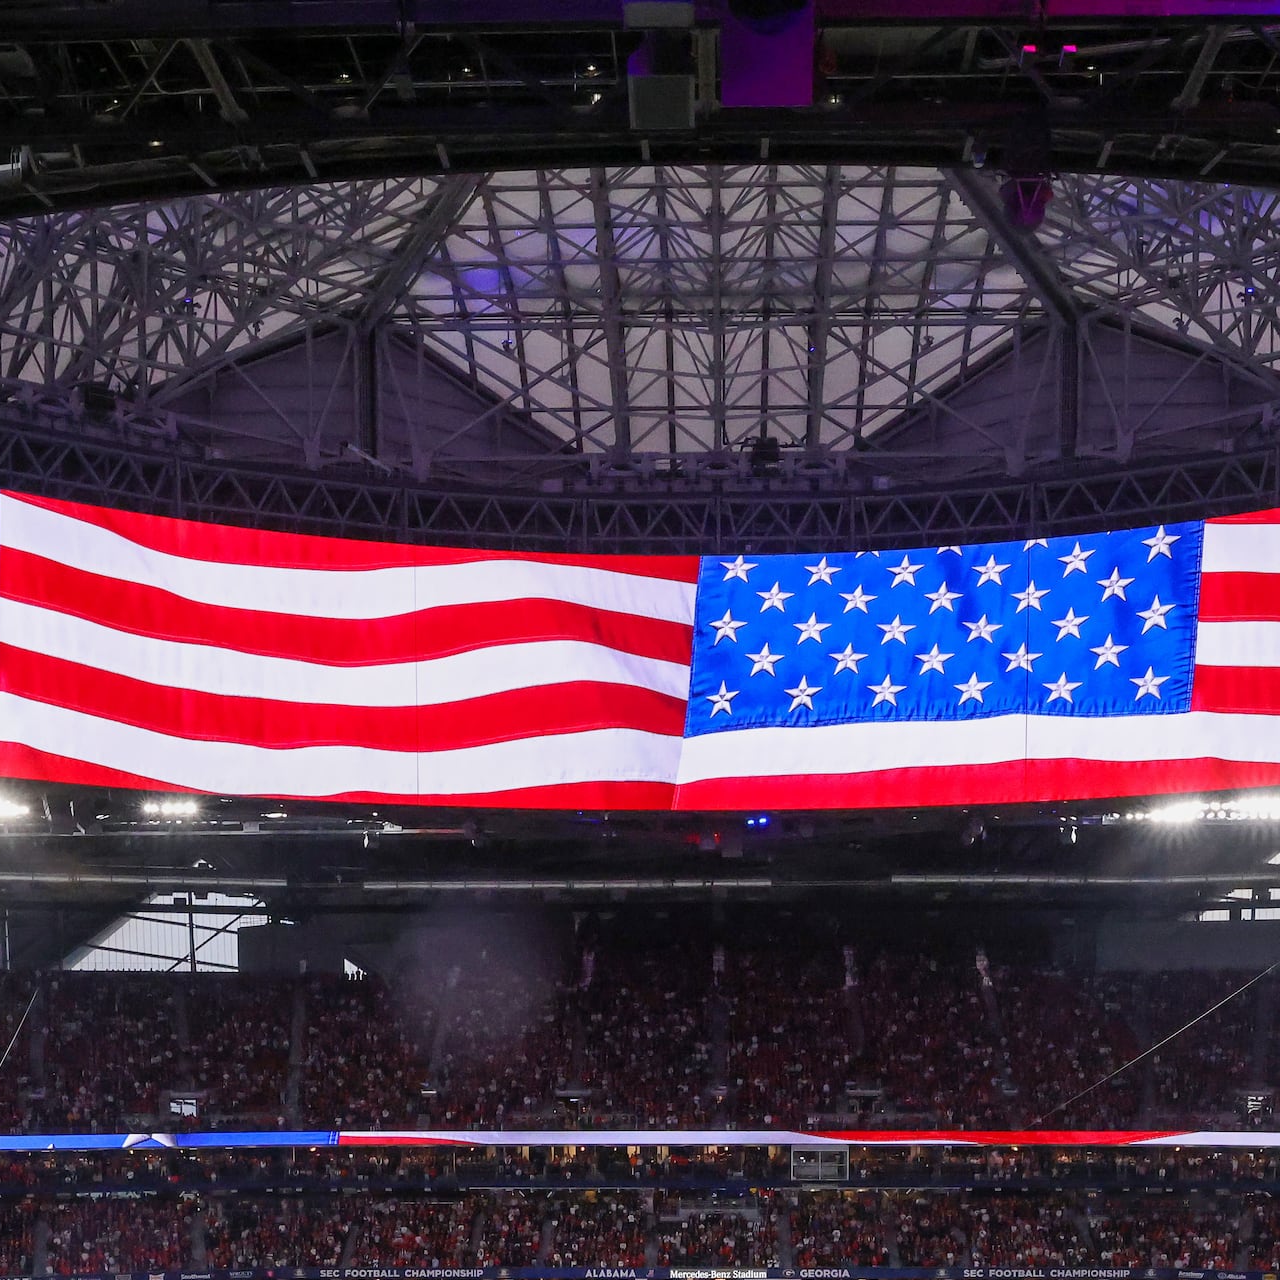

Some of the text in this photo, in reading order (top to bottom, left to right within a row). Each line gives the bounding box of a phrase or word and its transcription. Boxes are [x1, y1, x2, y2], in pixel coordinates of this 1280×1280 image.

[320, 1269, 484, 1278] SEC FOOTBALL CHAMPIONSHIP
[585, 1269, 636, 1278] ALABAMA
[670, 1269, 767, 1279] Mercedes-Benz Stadium
[799, 1269, 850, 1278] GEORGIA
[963, 1269, 1131, 1278] SEC FOOTBALL CHAMPIONSHIP
